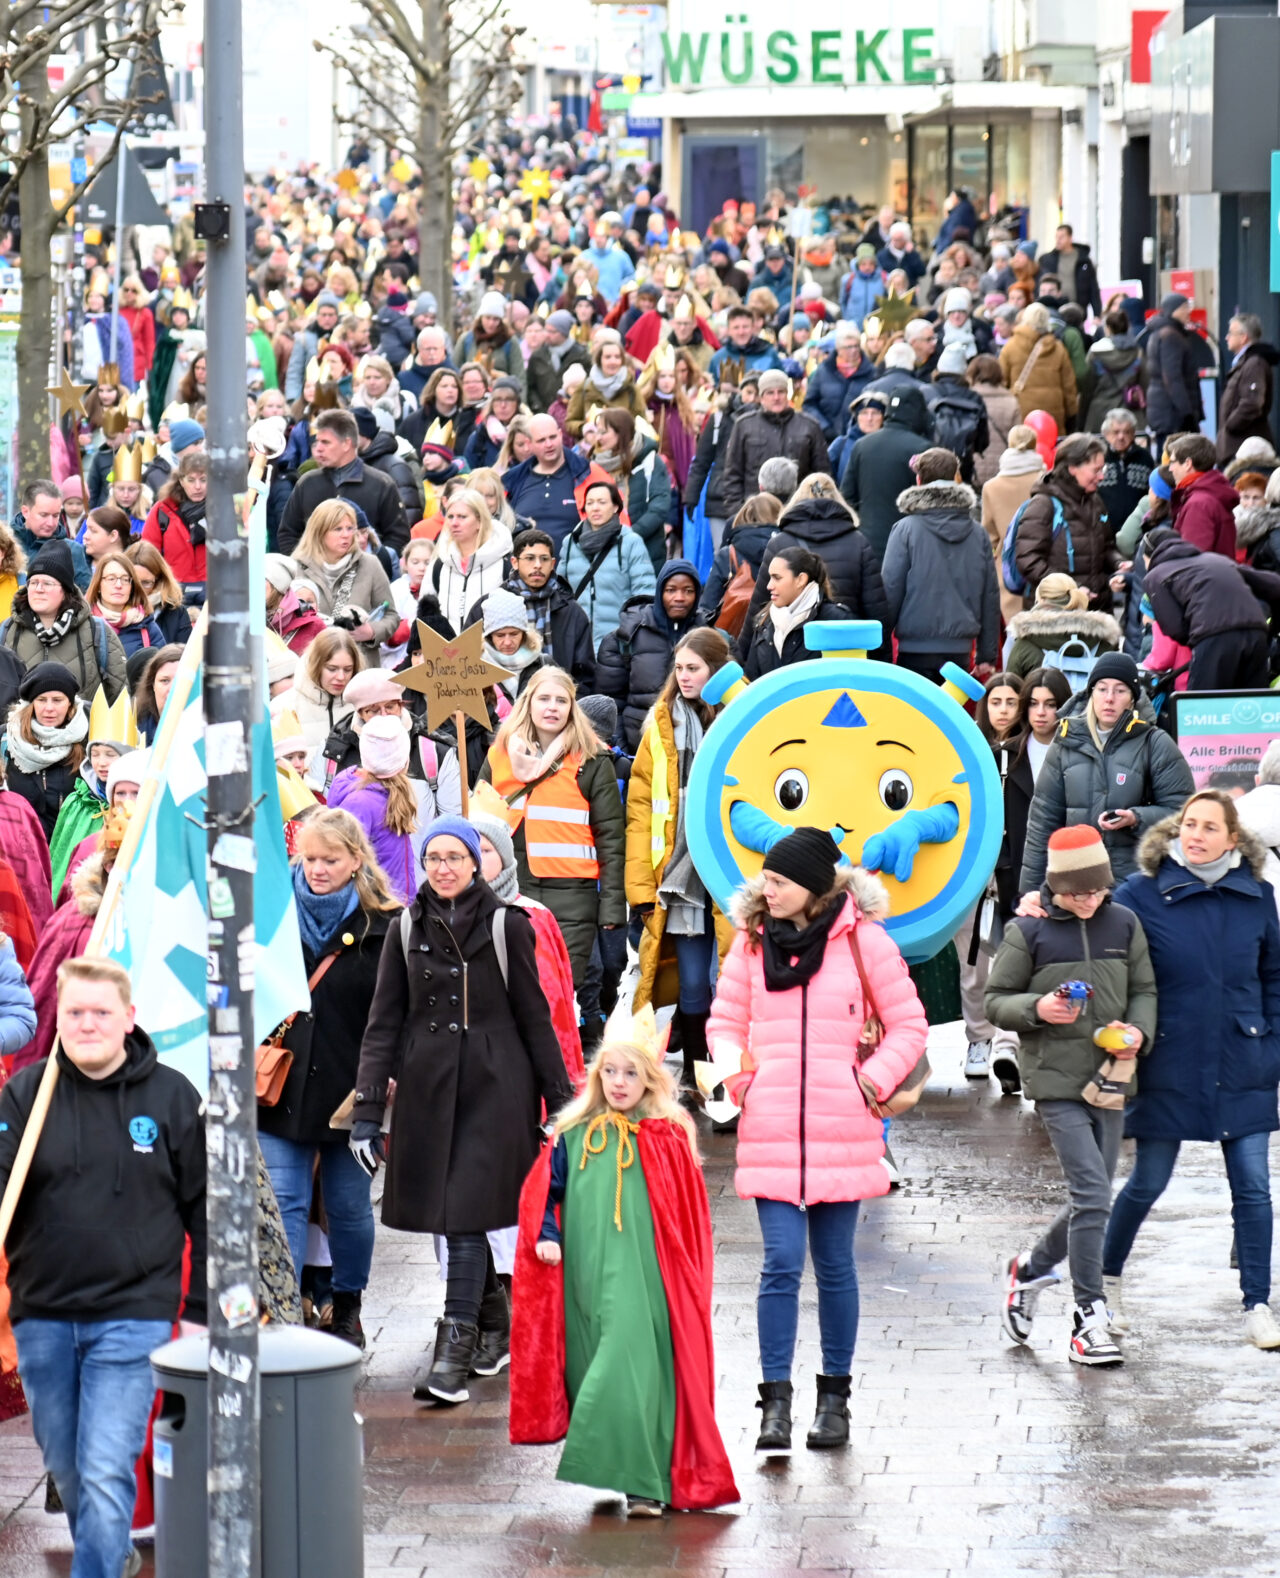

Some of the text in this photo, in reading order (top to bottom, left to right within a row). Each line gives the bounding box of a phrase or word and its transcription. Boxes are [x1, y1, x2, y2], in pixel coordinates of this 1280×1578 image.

[660, 14, 937, 84] WÜSEKE
[1184, 713, 1232, 726] SMILE
[1190, 744, 1262, 757] Alle Brillen
